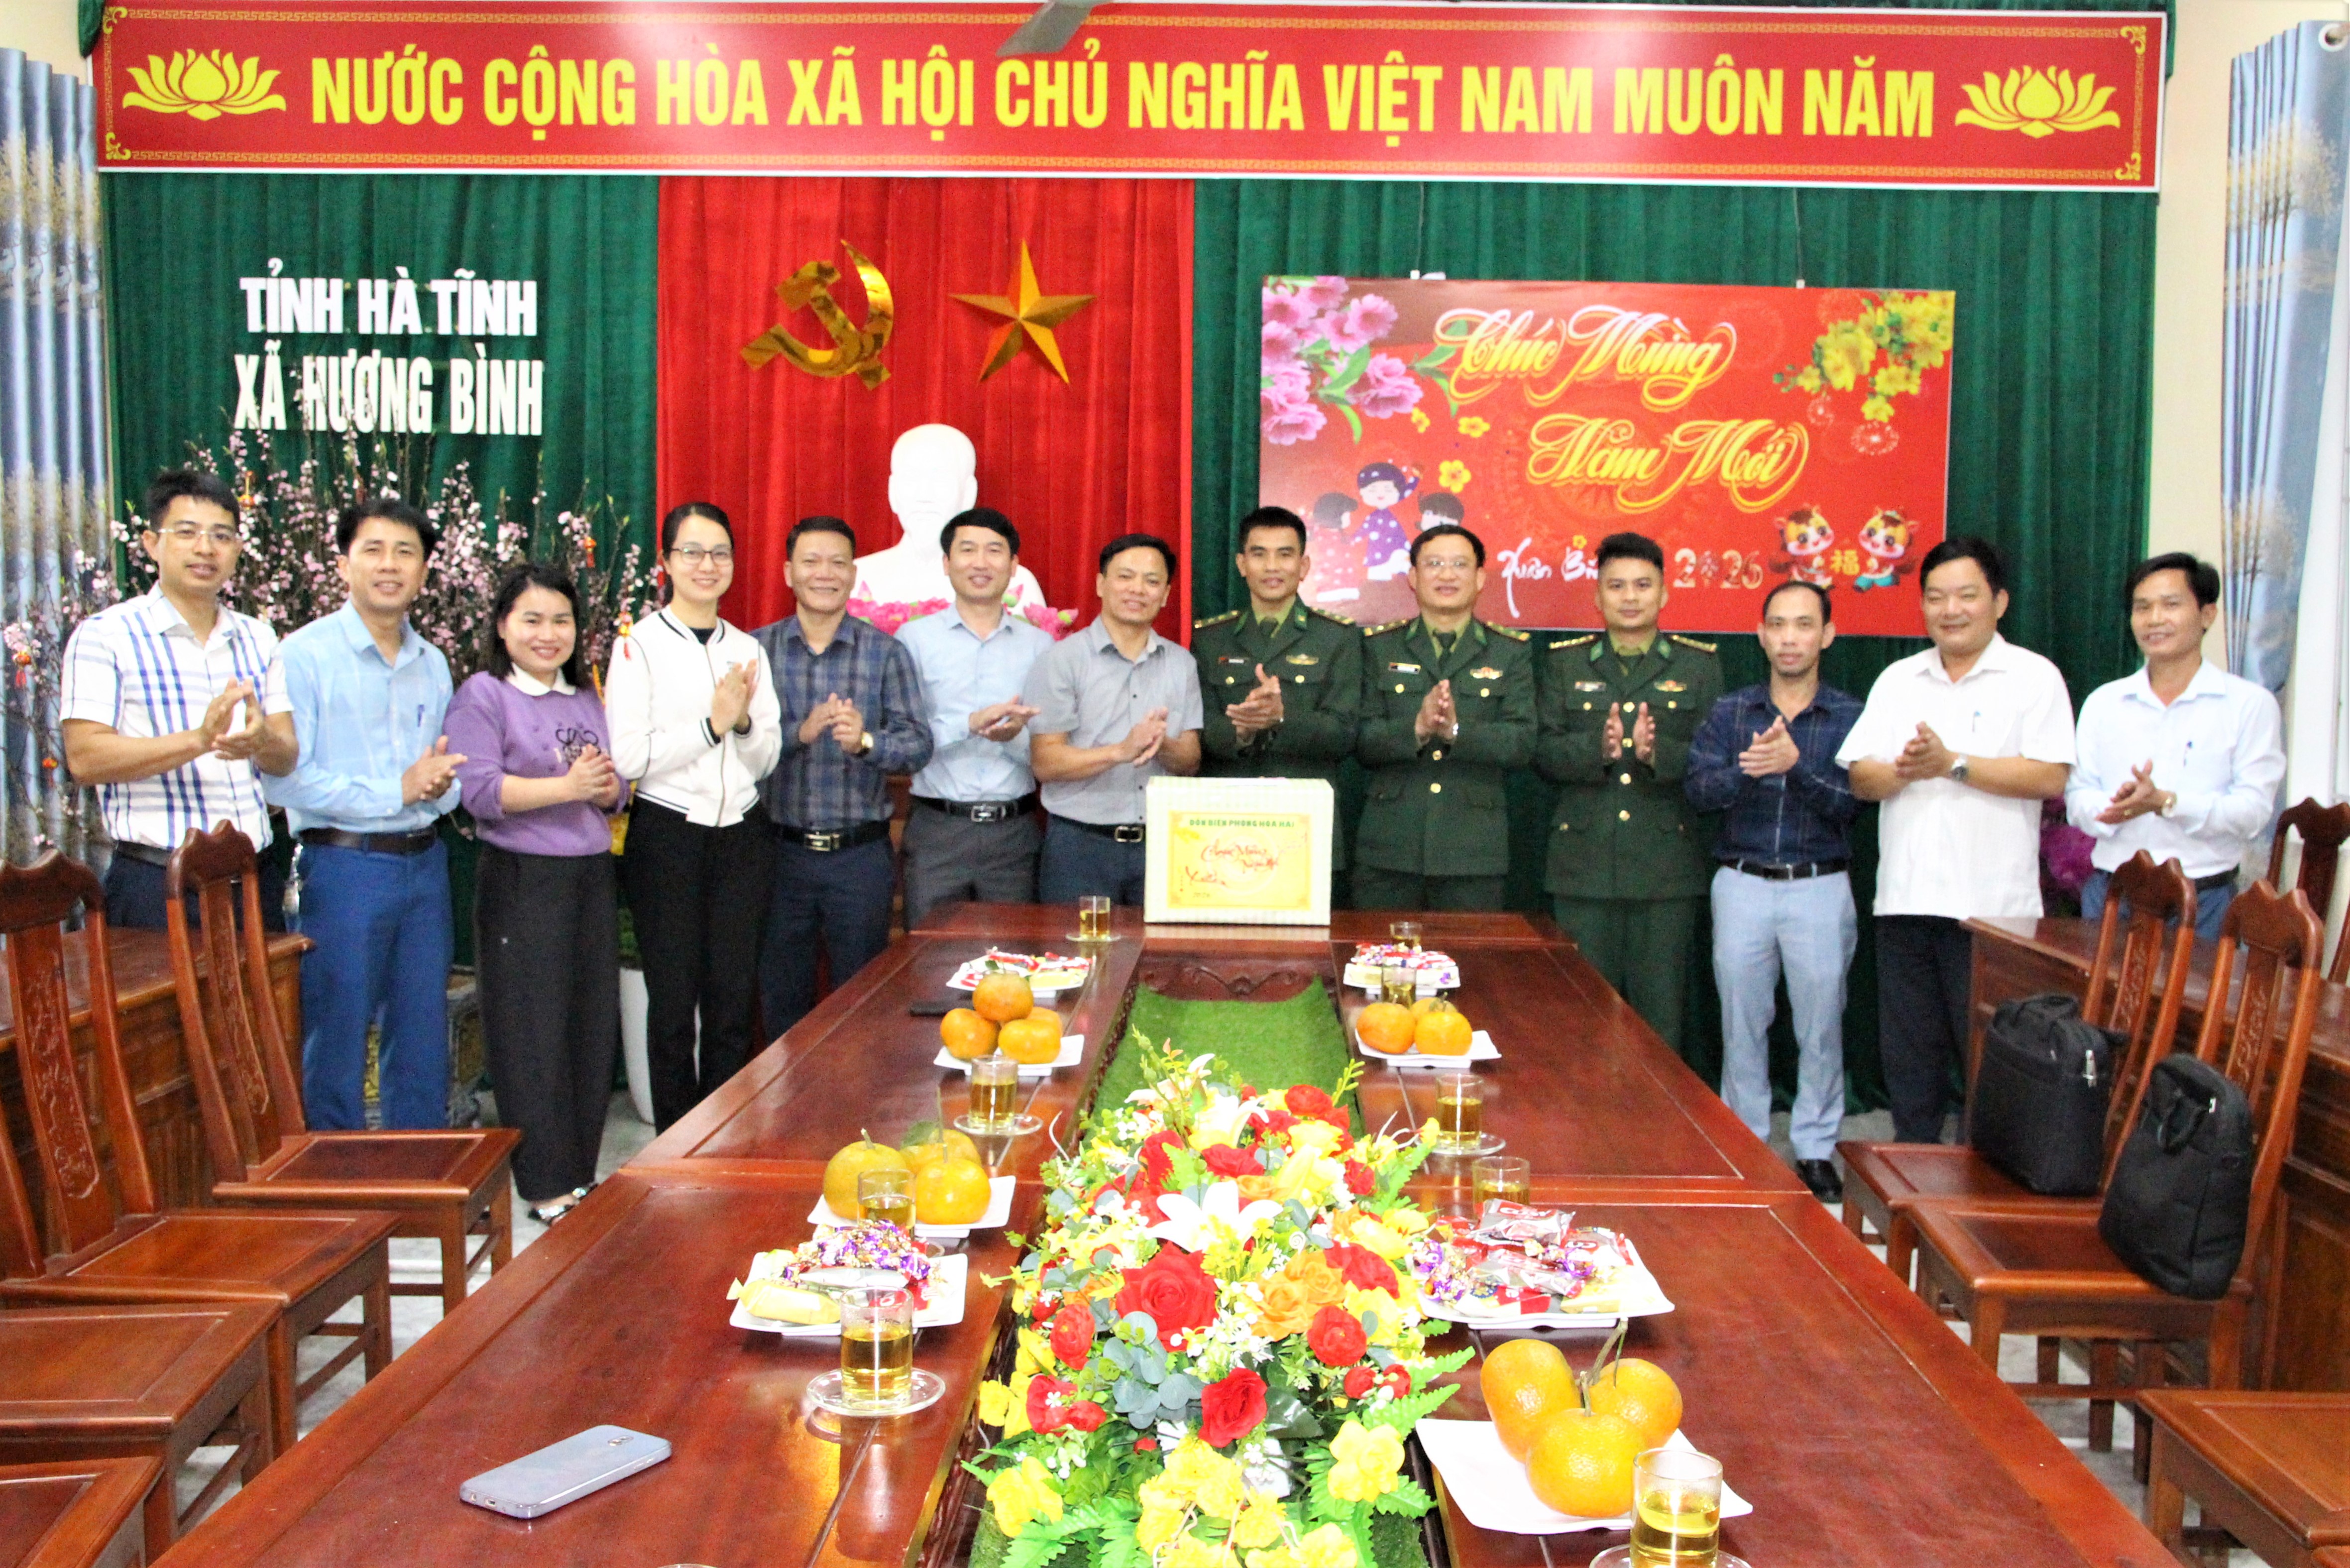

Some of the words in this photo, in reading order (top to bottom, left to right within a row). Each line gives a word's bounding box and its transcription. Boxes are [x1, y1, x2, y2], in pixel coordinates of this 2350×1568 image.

[312, 44, 463, 125] NƯỚC
[484, 45, 636, 141] CỘNG
[655, 43, 770, 127] HÒA
[786, 46, 863, 126] XÃ
[882, 44, 974, 141] HỘI
[995, 40, 1108, 128] CHỦ
[1128, 50, 1305, 131] NGHĨA
[1323, 50, 1443, 147] VIỆT
[1460, 66, 1594, 134] NAM
[1613, 53, 1784, 136] MUÔN
[1803, 55, 1934, 137] NĂM
[240, 257, 343, 333] TỈNH
[357, 266, 423, 335] HÀ
[430, 268, 537, 336] TĨNH
[234, 339, 287, 430] XÃ
[302, 348, 433, 435] HƯƠNG
[450, 342, 543, 436] BÌNH
[1435, 308, 1566, 405] Chúc
[1525, 305, 1737, 412] Mừng
[1527, 413, 1663, 488] Năm
[1617, 418, 1809, 512] Mới
[1497, 537, 1553, 618] Xuân
[1830, 549, 1860, 575] 福
